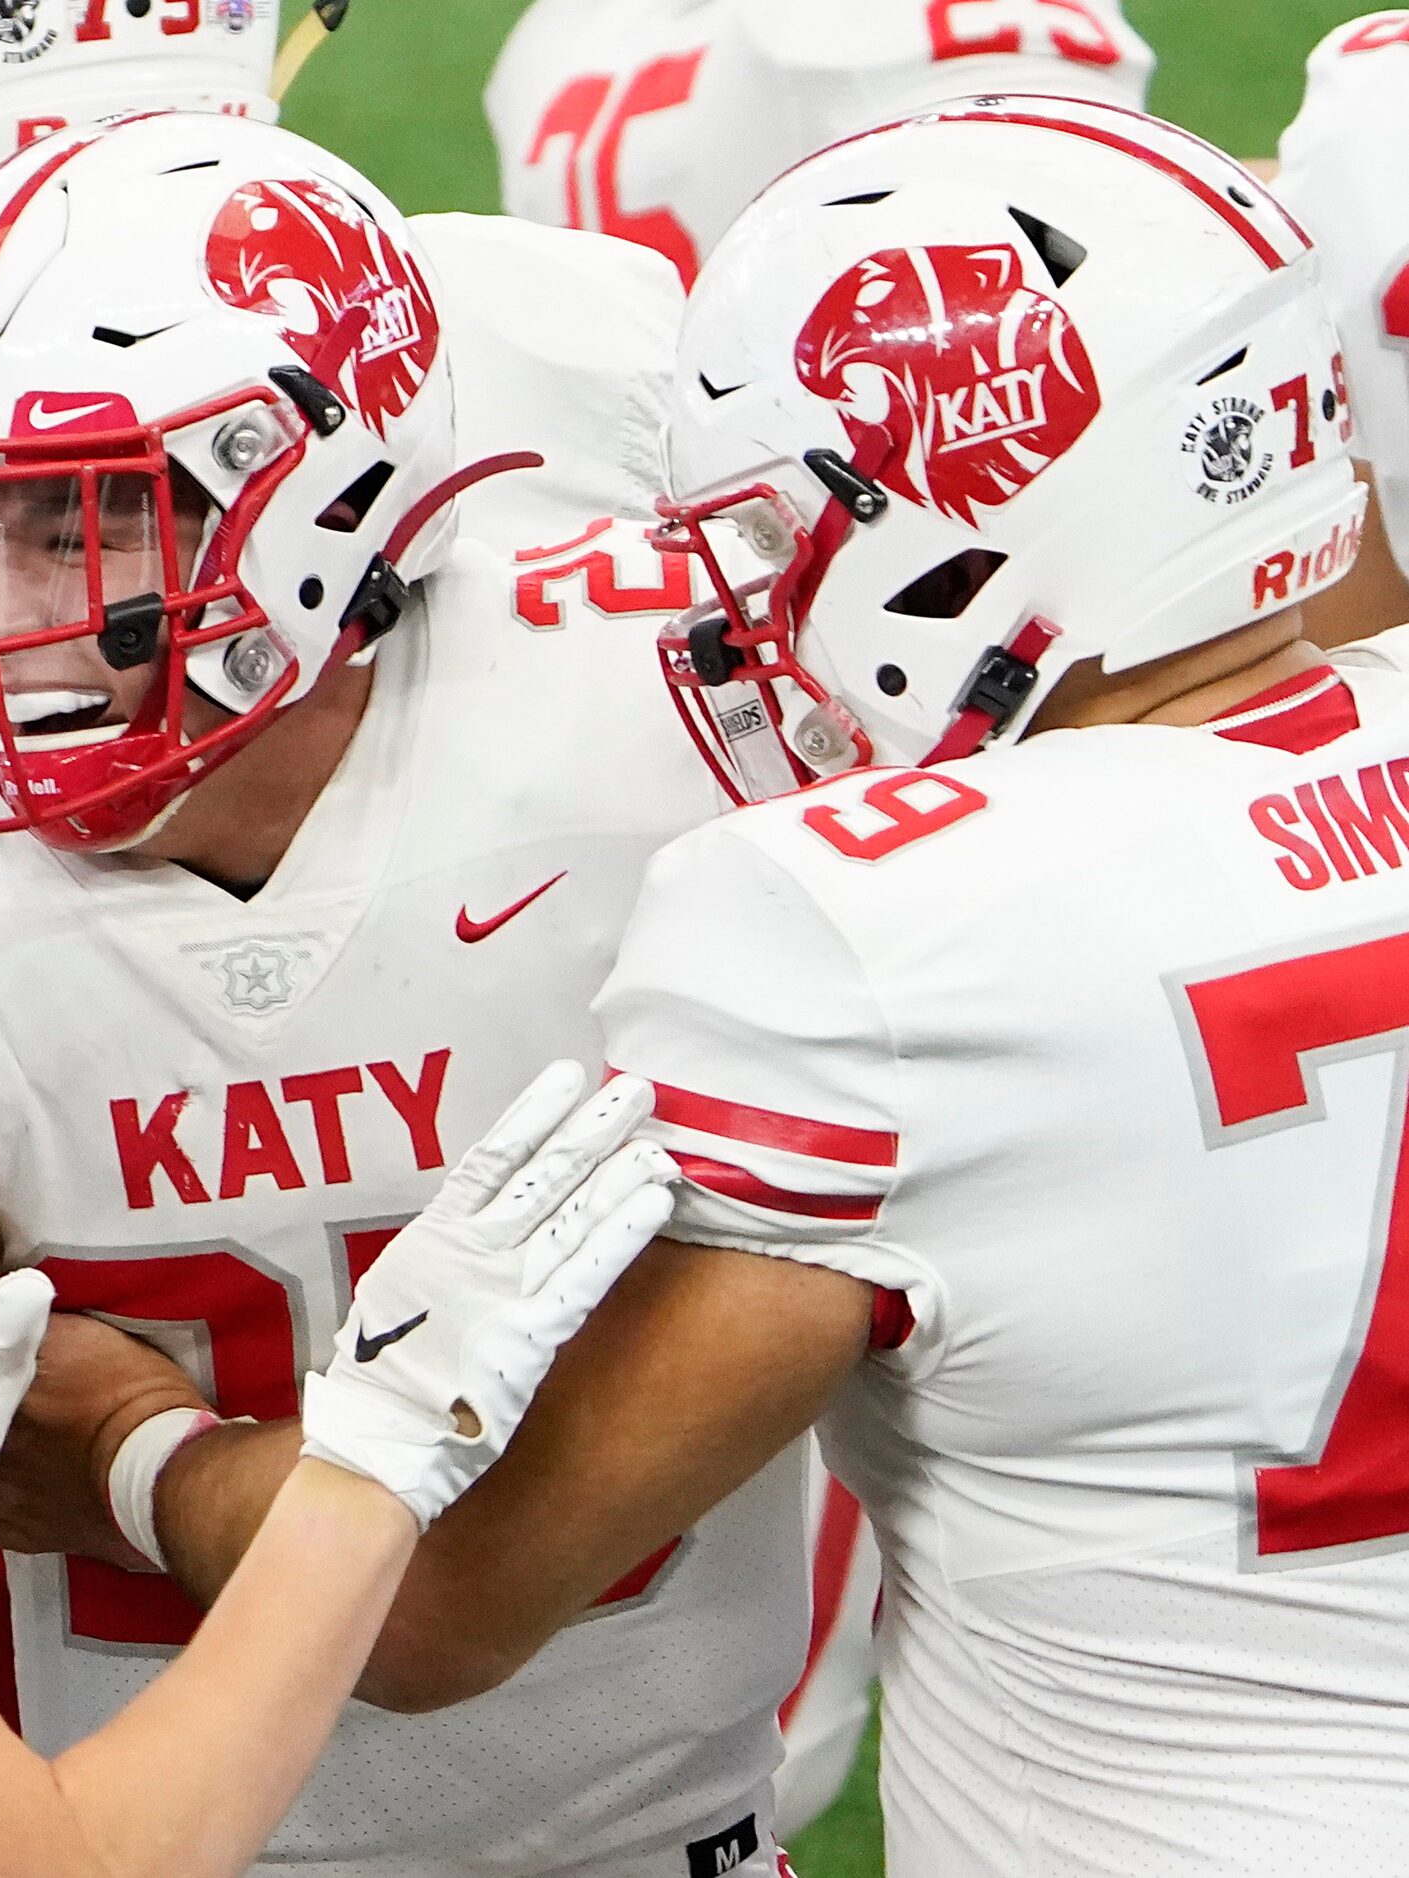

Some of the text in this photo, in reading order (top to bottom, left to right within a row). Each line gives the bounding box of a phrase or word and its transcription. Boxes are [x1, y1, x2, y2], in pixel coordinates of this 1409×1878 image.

[934, 364, 1047, 453] KATY
[1181, 412, 1207, 454] KATY
[109, 1047, 452, 1210] KATY
[714, 1838, 741, 1875] M
